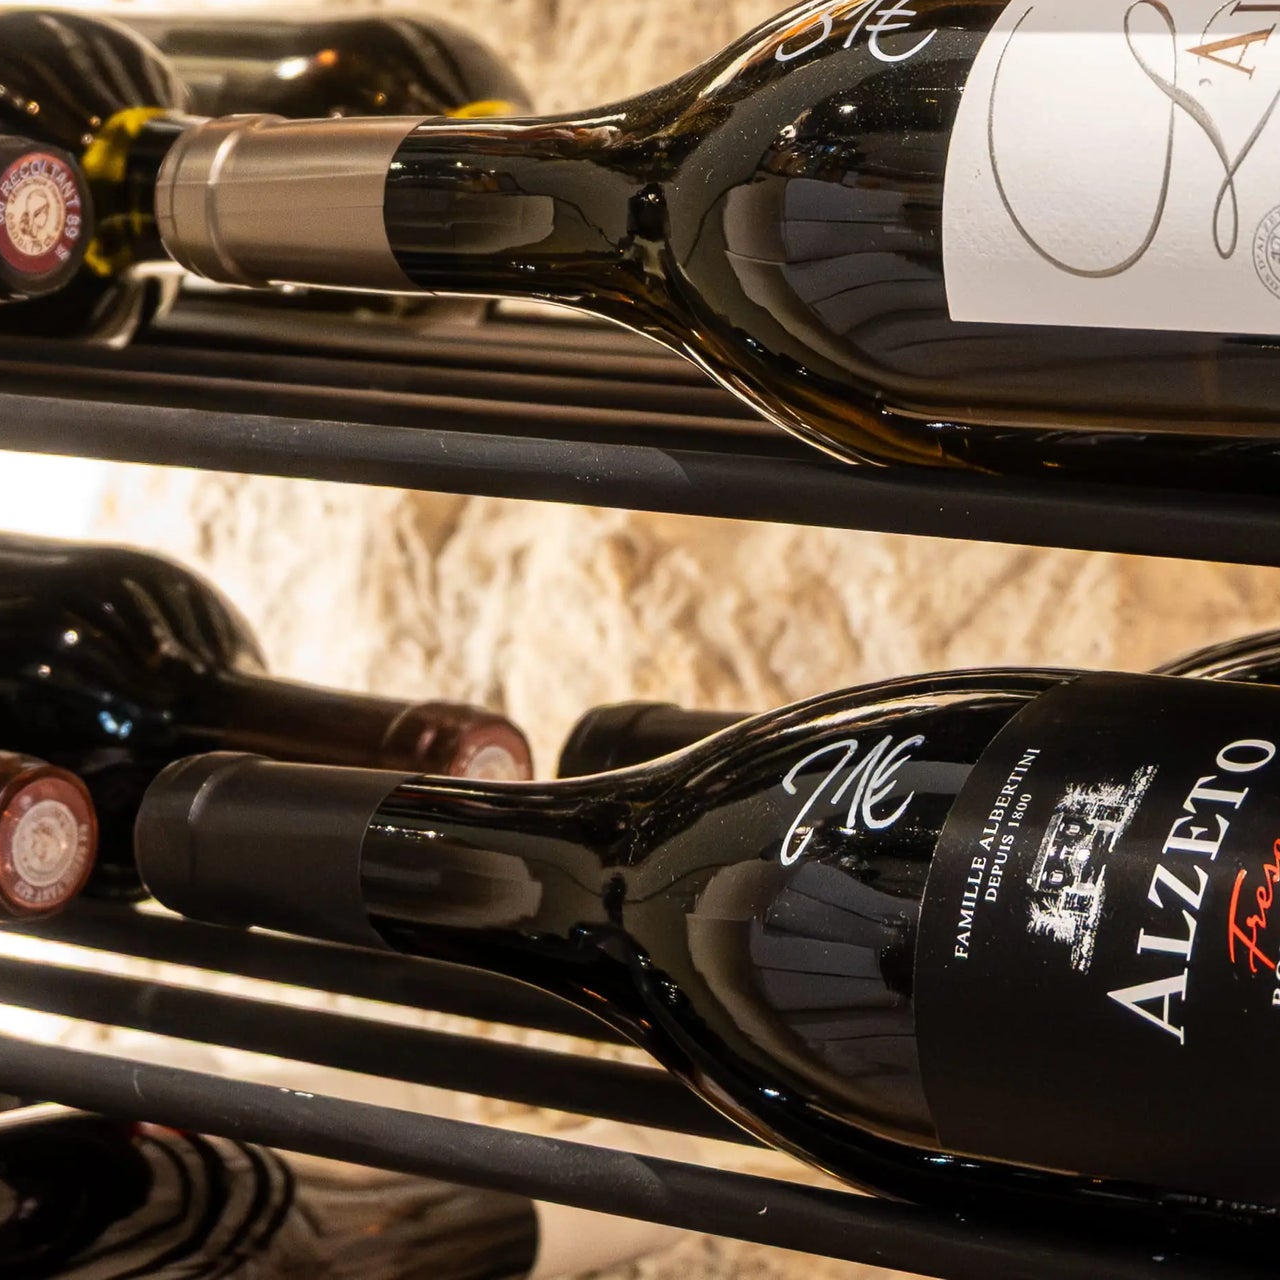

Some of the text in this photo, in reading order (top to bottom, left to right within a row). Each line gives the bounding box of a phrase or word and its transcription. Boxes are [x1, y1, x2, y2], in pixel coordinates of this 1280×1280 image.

[780, 734, 926, 867] 21€
[954, 747, 1041, 960] FAMILLE ALBERTINI
[984, 793, 1032, 903] DEPUIS 1800
[1106, 738, 1277, 1046] ALZETO
